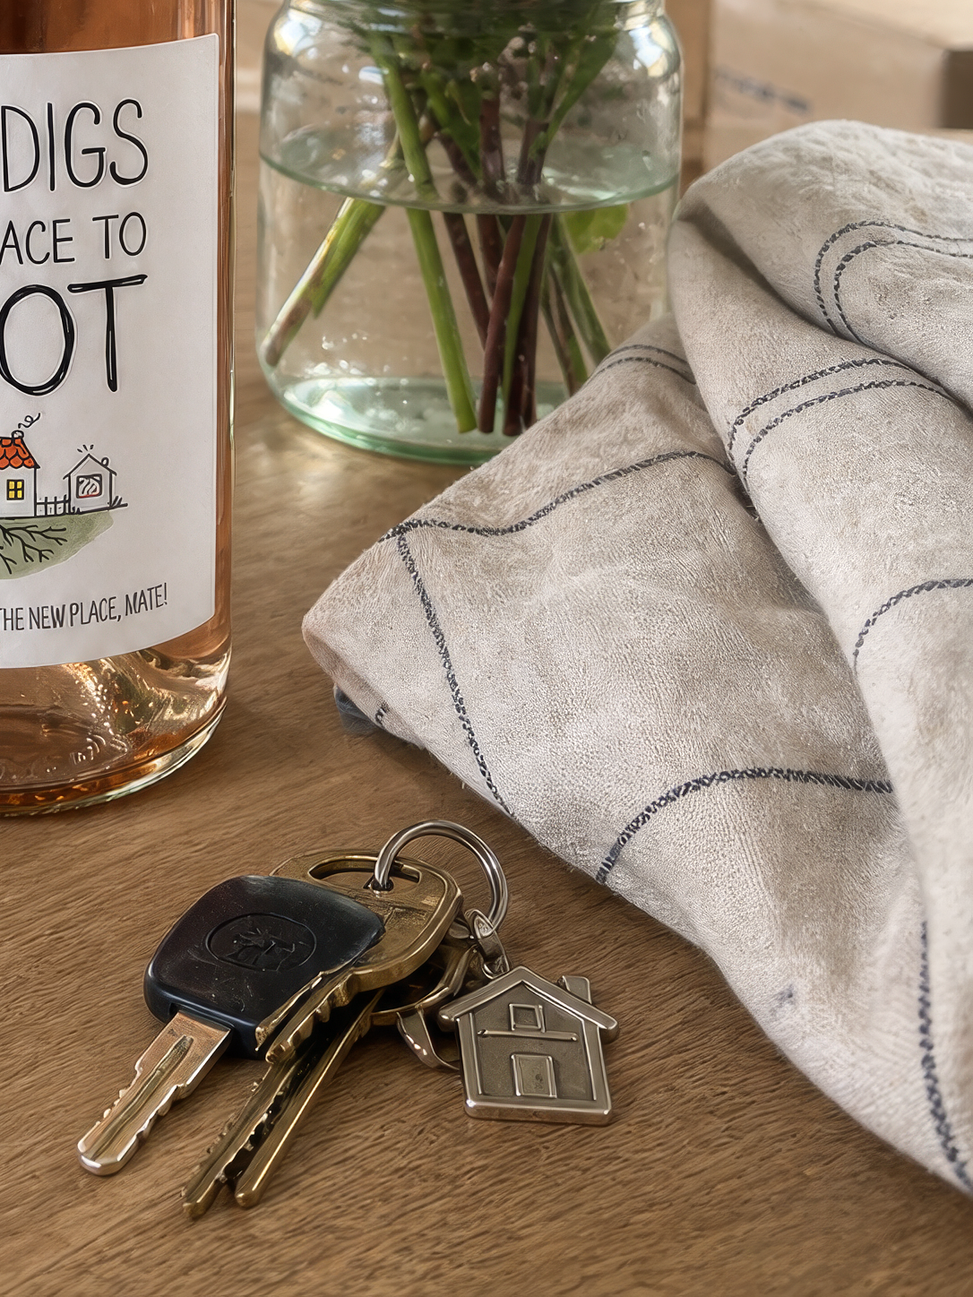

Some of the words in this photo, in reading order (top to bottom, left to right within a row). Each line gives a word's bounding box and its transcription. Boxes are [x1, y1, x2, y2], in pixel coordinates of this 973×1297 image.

[0, 98, 149, 193] DIGS
[91, 211, 147, 260] TO
[29, 603, 66, 630] NEW
[69, 595, 122, 628] PLACE,
[124, 582, 168, 617] MATE!
